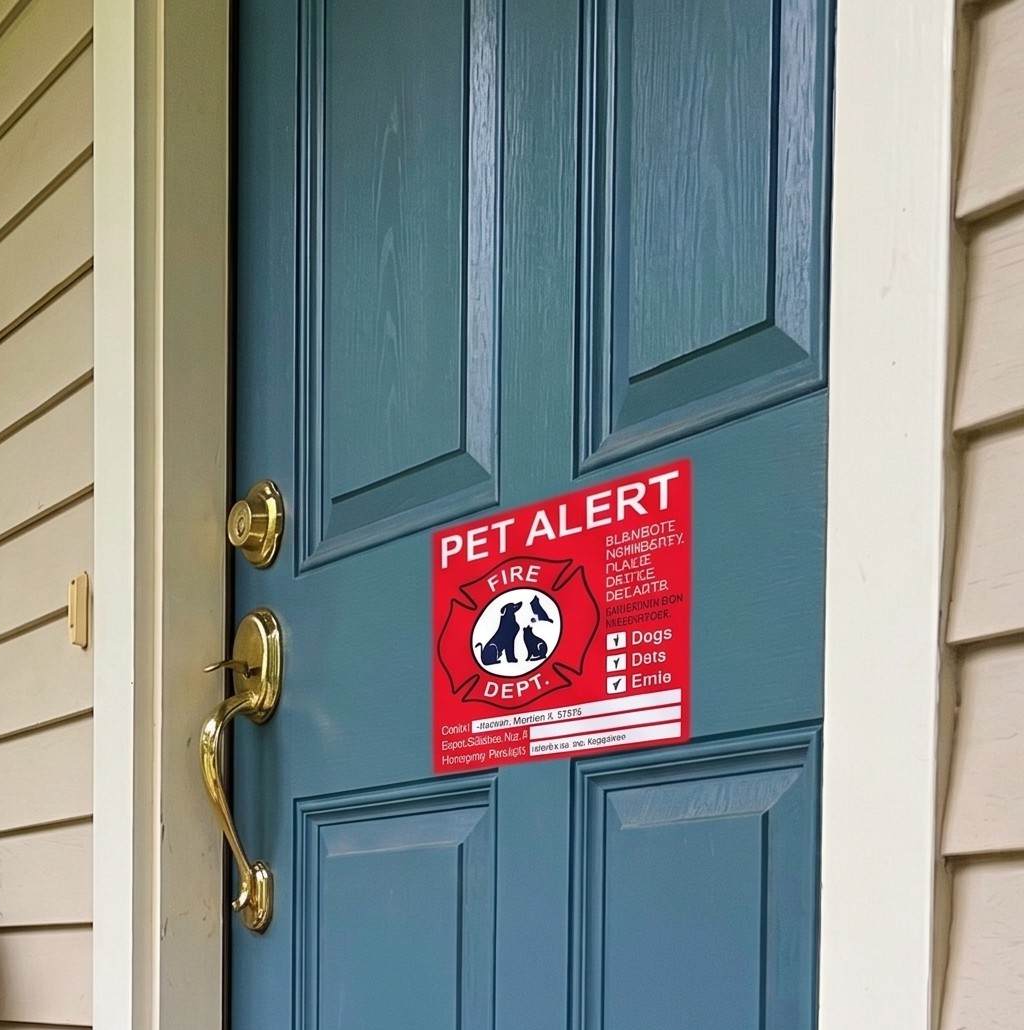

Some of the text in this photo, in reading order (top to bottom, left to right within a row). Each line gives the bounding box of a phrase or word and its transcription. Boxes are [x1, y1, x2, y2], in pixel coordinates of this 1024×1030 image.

[441, 470, 680, 569] PET ALERT
[487, 565, 541, 592] FIRE
[632, 628, 673, 646] Dogs
[484, 673, 550, 699] DEPT.
